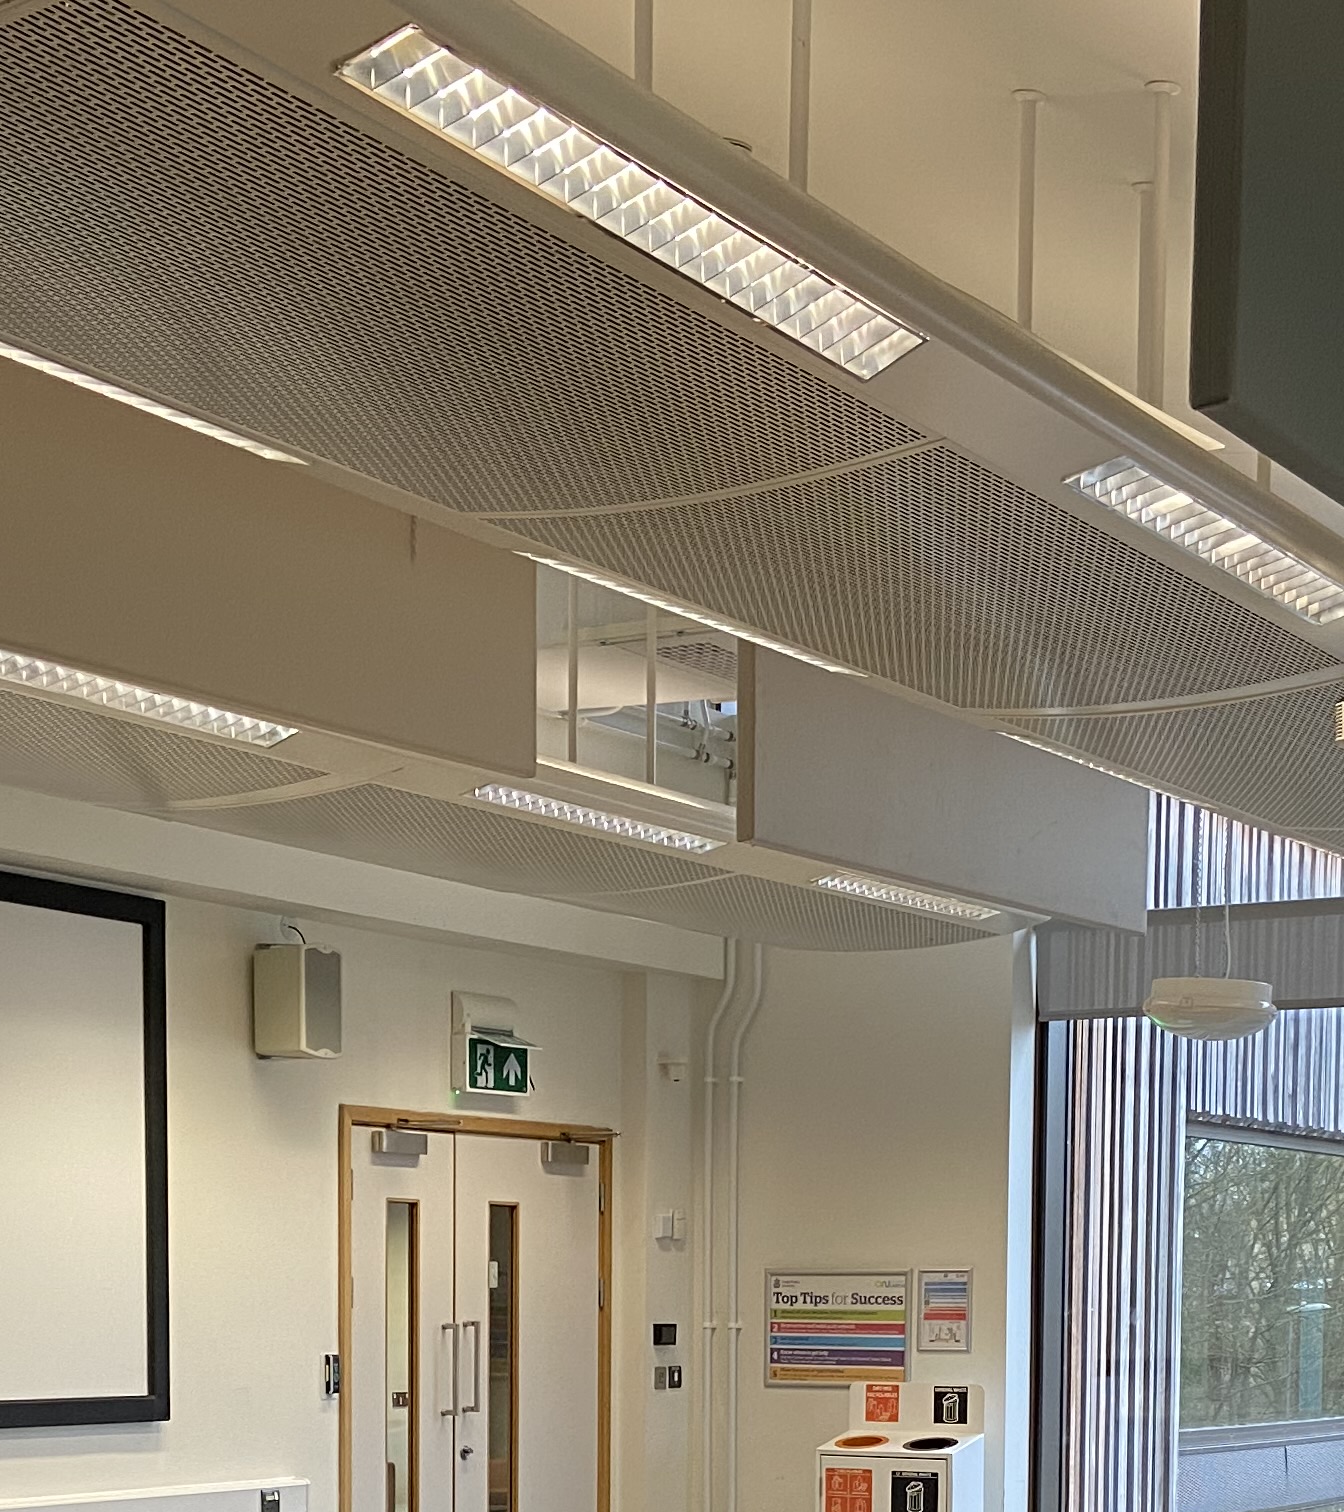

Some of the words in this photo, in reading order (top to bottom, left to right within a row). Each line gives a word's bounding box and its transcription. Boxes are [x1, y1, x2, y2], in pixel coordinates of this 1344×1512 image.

[773, 1292, 798, 1306] Top
[801, 1292, 829, 1306] Tips
[831, 1292, 849, 1305] for
[850, 1292, 904, 1305] Success
